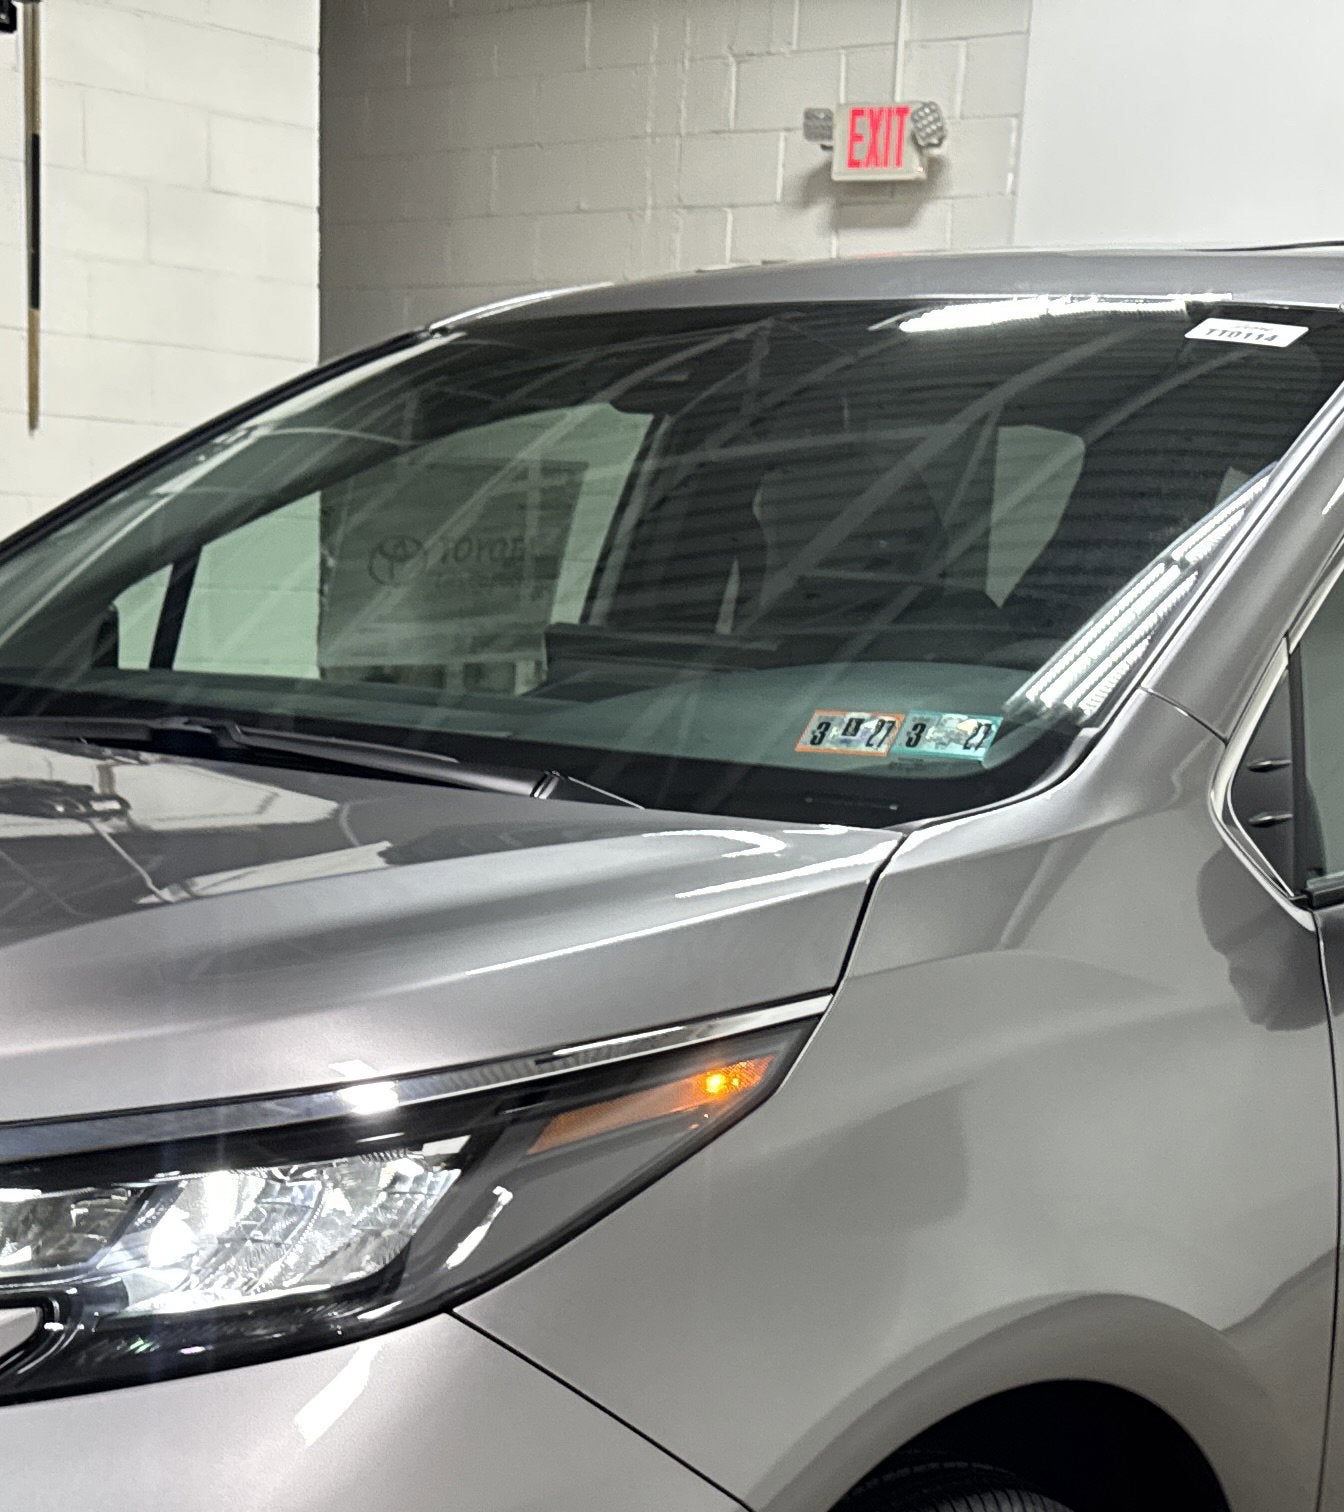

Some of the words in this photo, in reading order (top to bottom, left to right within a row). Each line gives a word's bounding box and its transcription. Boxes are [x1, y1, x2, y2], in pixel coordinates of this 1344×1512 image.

[847, 106, 910, 169] EXIT
[810, 721, 831, 746] 3
[865, 719, 896, 748] 27
[905, 723, 926, 748] 3
